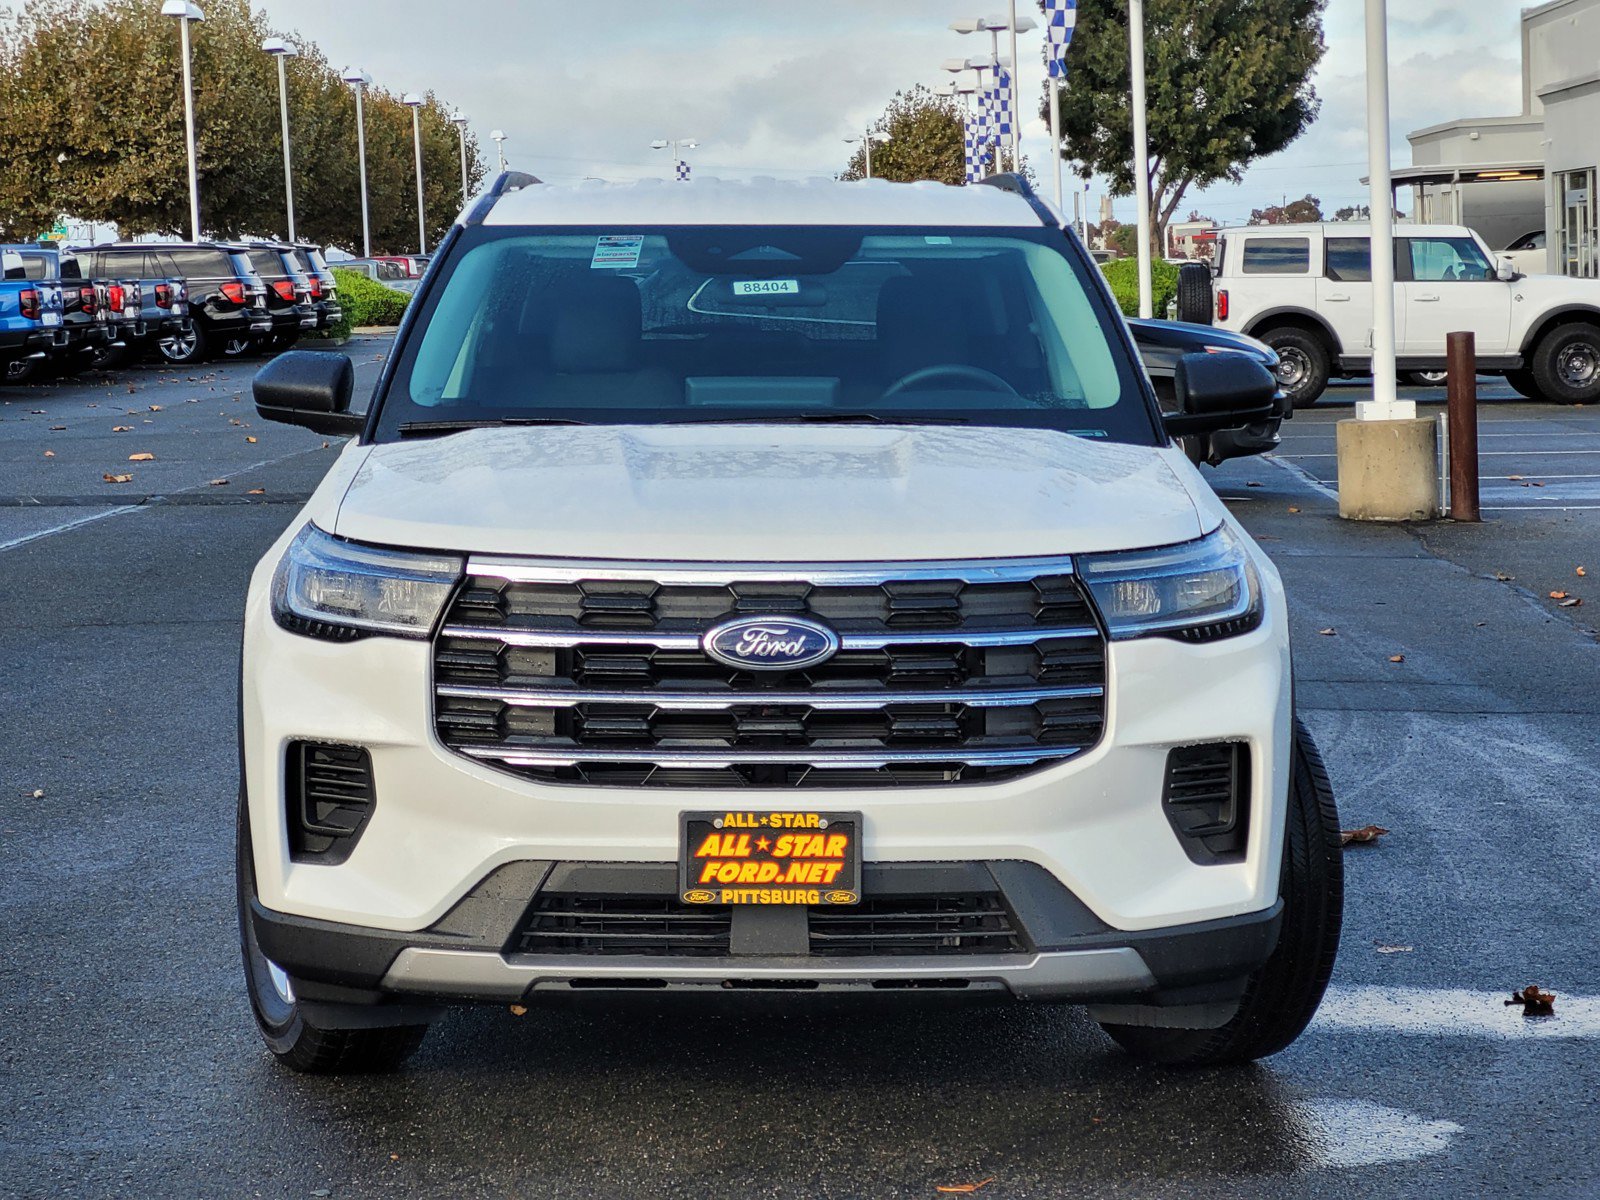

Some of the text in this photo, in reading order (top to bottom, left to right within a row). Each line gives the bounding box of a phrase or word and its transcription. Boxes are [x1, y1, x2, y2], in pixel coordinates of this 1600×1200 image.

[743, 282, 789, 292] 88404
[735, 627, 806, 657] Ford
[723, 813, 820, 828] ALL STAR
[695, 833, 848, 858] ALL STAR
[699, 861, 845, 884] FORD.NET
[689, 891, 710, 902] Ford
[721, 889, 820, 905] PITTSBURG
[831, 891, 851, 902] Ford
